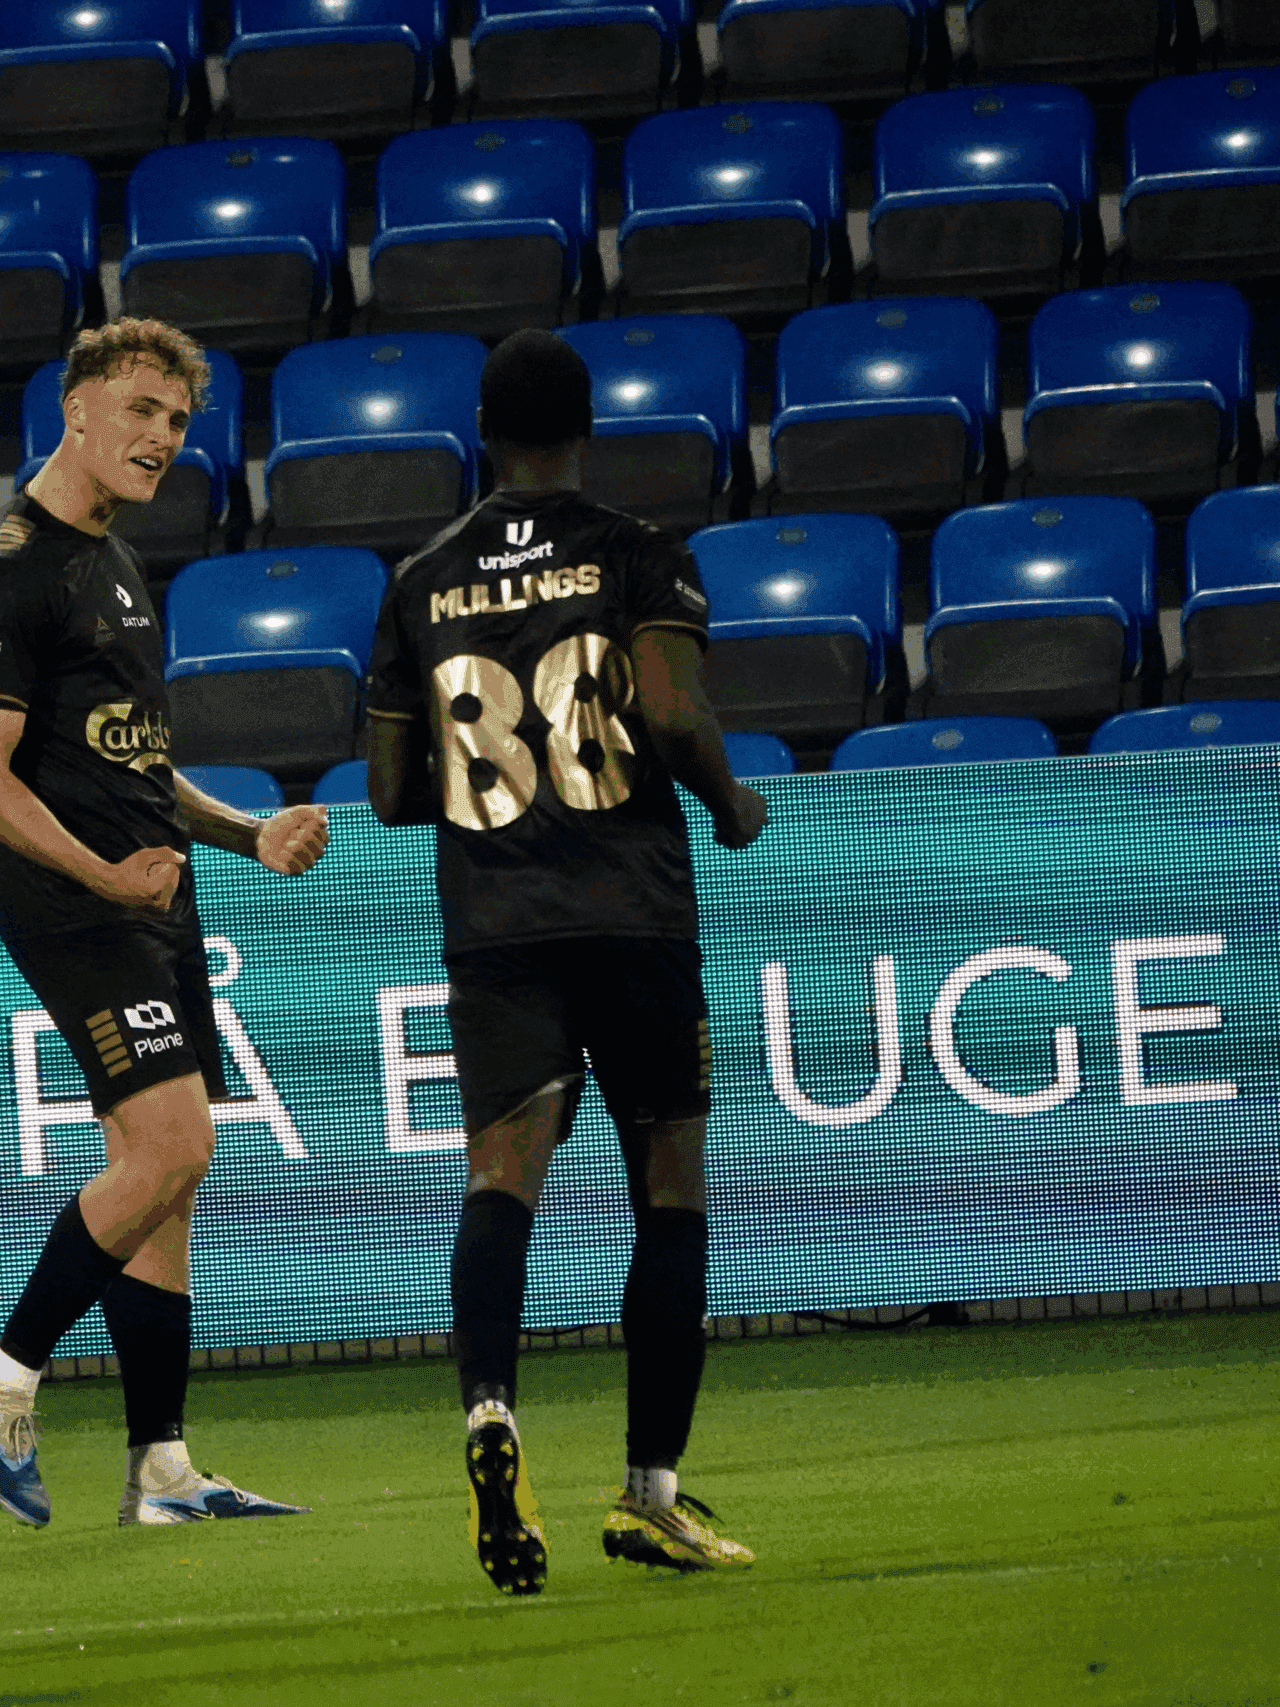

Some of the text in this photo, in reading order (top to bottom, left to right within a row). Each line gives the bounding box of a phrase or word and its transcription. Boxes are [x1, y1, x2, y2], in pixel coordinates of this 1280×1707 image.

[478, 540, 553, 571] unisport
[430, 563, 601, 625] MULLINGS
[121, 616, 151, 628] DATUM
[133, 1032, 184, 1059] Plane
[760, 932, 1240, 1129] UGE
